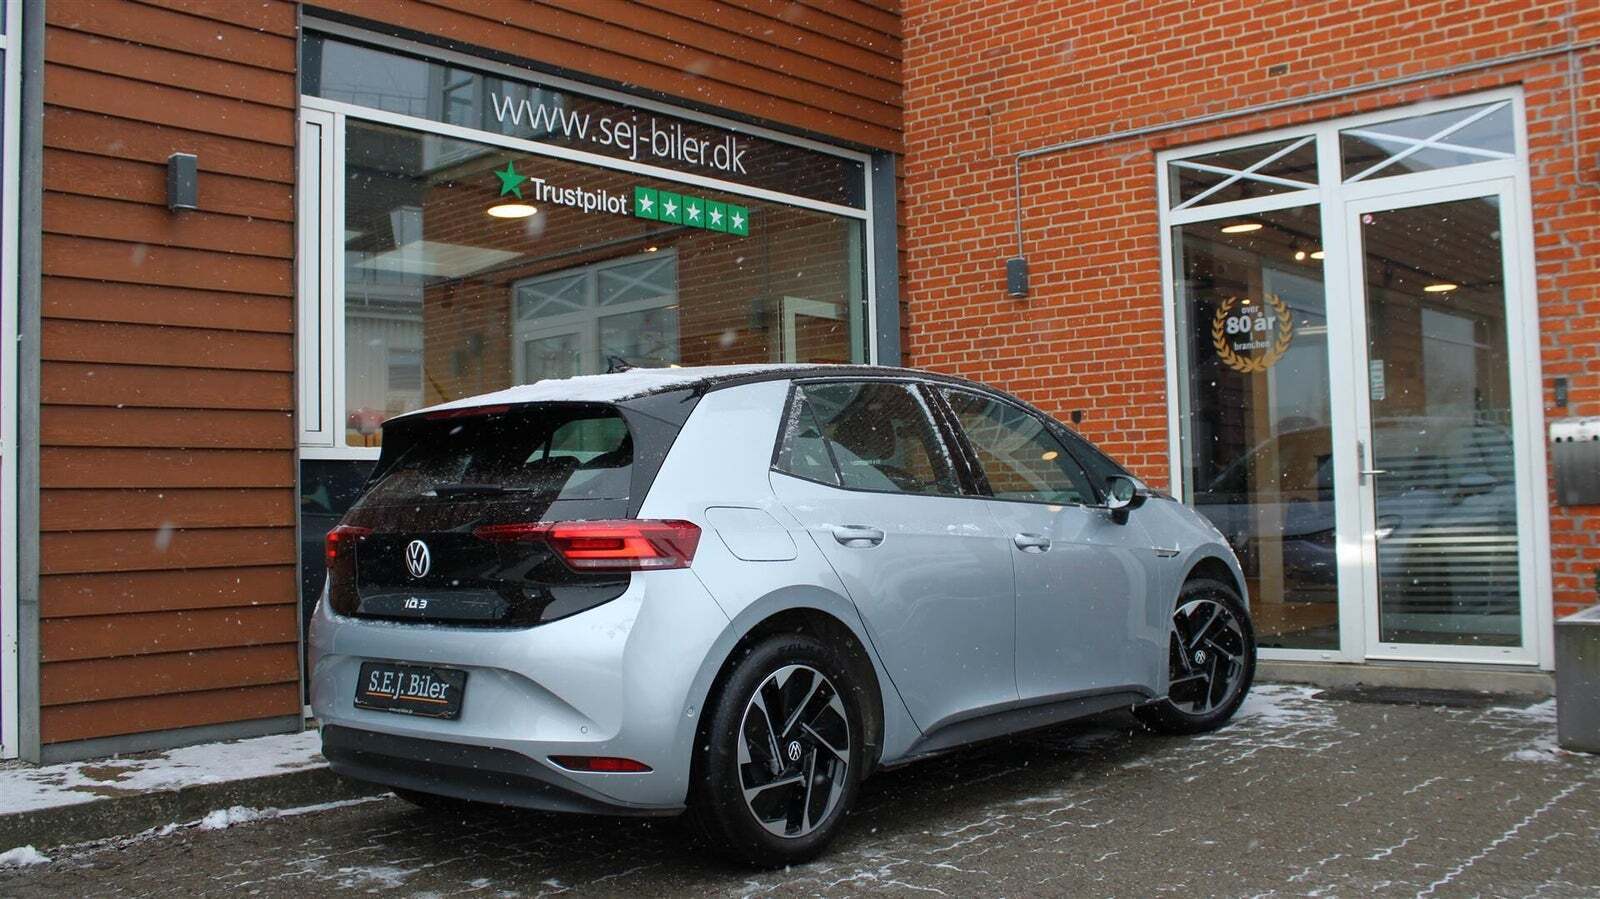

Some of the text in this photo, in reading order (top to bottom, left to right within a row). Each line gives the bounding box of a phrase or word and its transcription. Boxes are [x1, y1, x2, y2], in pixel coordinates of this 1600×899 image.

[491, 92, 748, 175] www.sej-biler.dk
[530, 176, 628, 215] Trustpilot
[1226, 312, 1276, 334] 80 år
[1233, 340, 1270, 351] branchen
[368, 669, 450, 700] S.E.J. Biler
